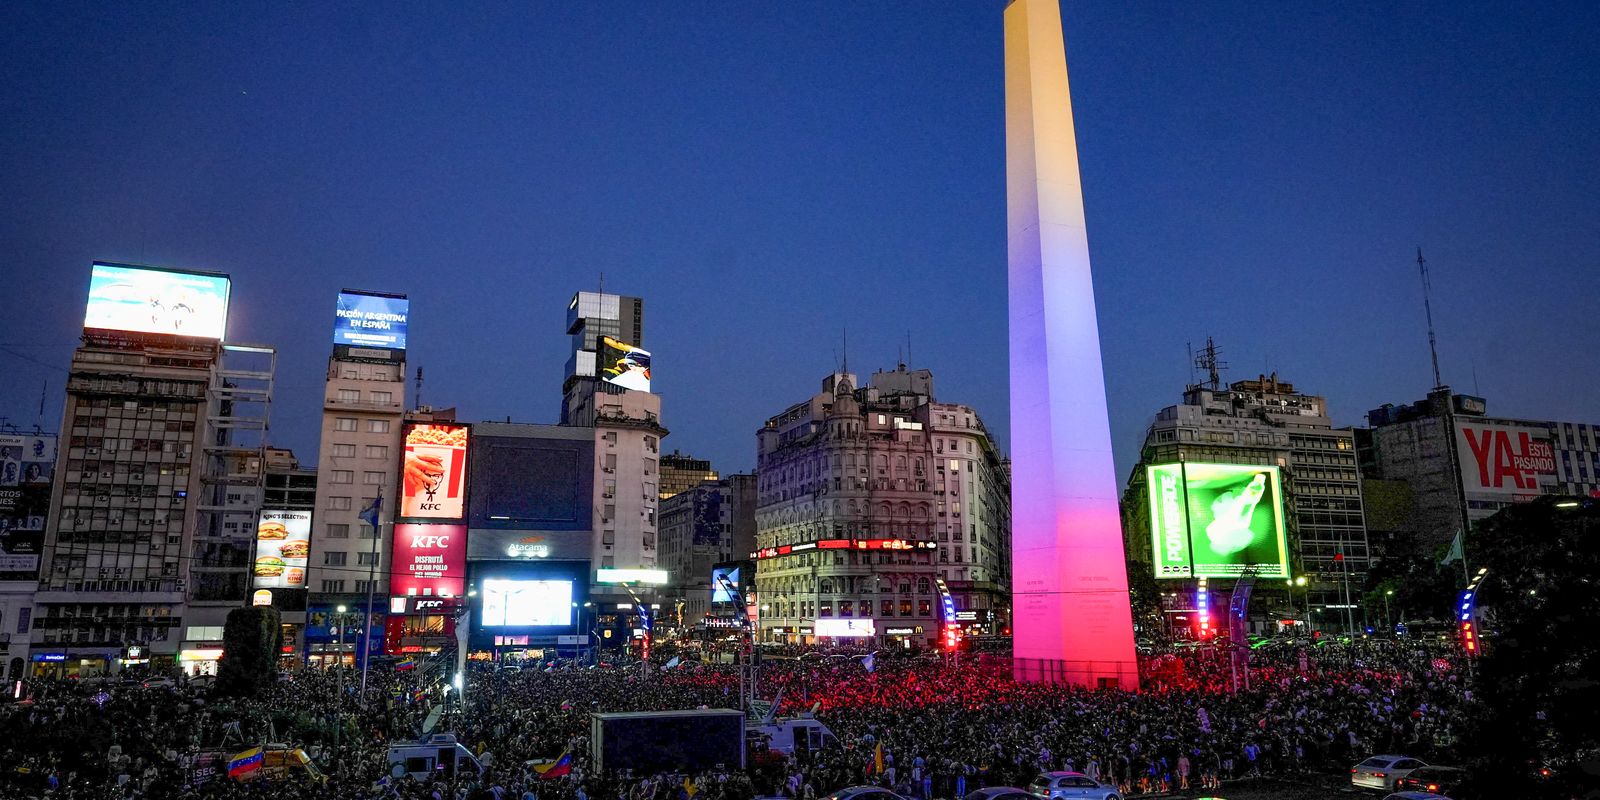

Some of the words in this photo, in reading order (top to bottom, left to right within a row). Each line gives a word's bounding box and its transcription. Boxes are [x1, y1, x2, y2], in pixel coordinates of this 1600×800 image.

[336, 309, 363, 319] PASIÓN
[364, 311, 406, 322] ARGENTINA
[350, 319, 361, 327] EN
[362, 320, 391, 330] ESPAÑA
[1528, 442, 1552, 457] ESTÁ
[1462, 428, 1537, 489] YA!
[1513, 456, 1554, 471] PASANDO
[263, 513, 281, 521] KING'S
[410, 535, 450, 548] KFC
[508, 543, 548, 551] Atacama
[415, 554, 443, 563] DISFRUTÁ
